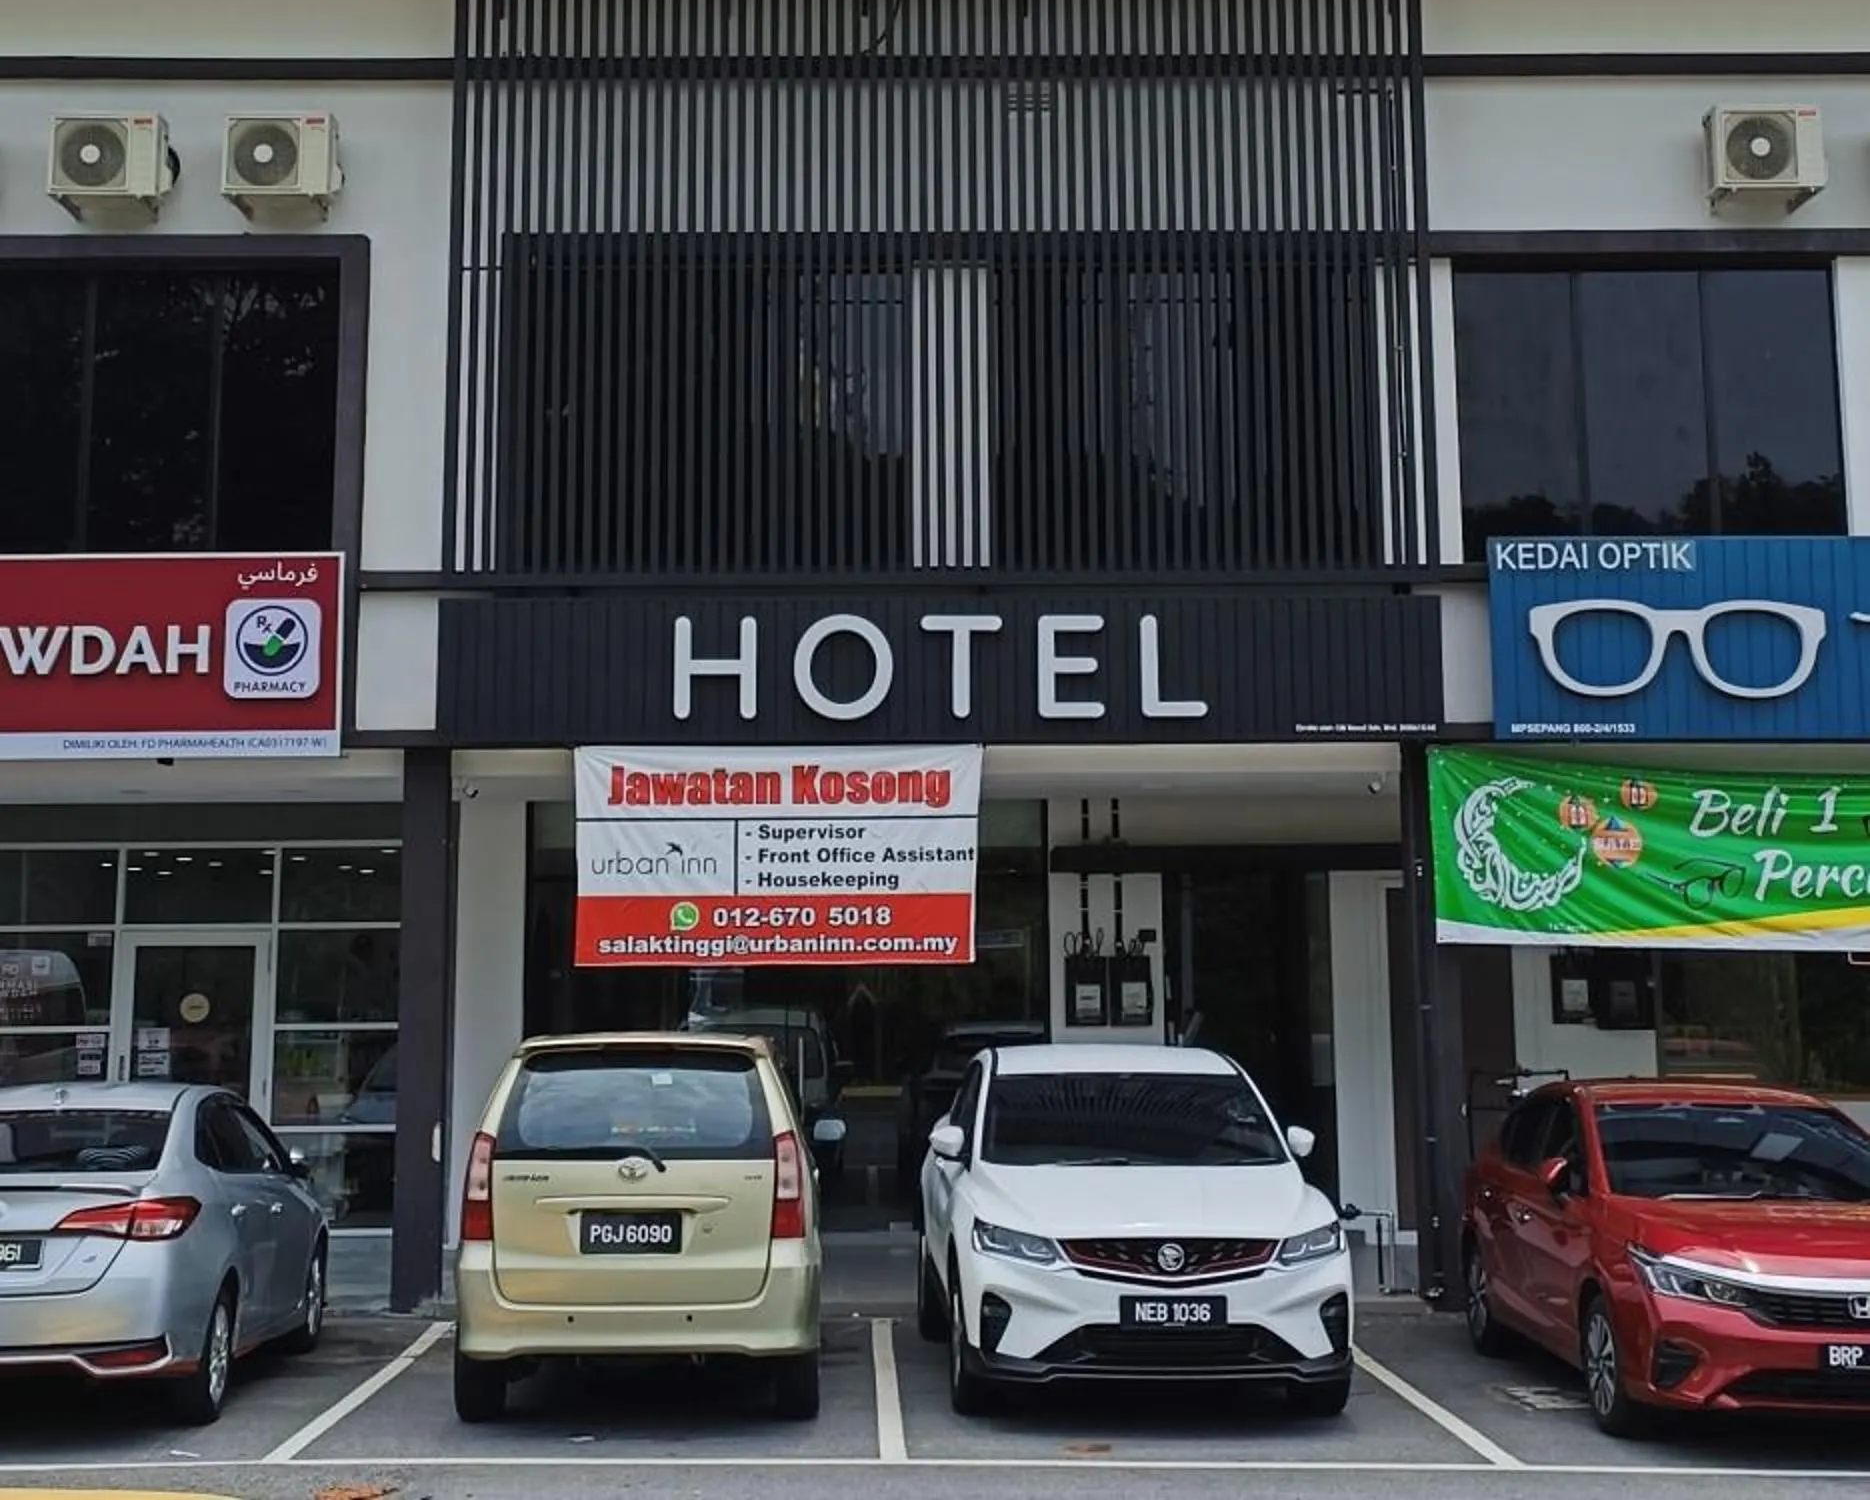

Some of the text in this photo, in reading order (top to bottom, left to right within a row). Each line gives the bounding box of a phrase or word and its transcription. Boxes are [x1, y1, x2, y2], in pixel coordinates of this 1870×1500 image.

[1496, 542, 1693, 570] KEDAI OPTIK
[237, 560, 319, 590] فرماسي
[673, 613, 1208, 721] HOTEL
[233, 681, 306, 693] PHARMACY
[158, 738, 244, 749] PHARMAHEALTH
[608, 764, 952, 808] Jawatan Kosong
[1689, 785, 1841, 838] Beli 1
[758, 824, 866, 842] Supervisor
[591, 846, 717, 876] urban inn
[758, 846, 974, 863] Front Office Assistant
[758, 872, 900, 890] Housekeeping
[1752, 849, 1870, 902] Perc
[713, 907, 892, 927] 012-670 5018
[598, 935, 958, 957] salaktinggi@urbaninn.com.my
[1134, 1302, 1211, 1322] NEB 1036
[1828, 1345, 1863, 1367] BRP
